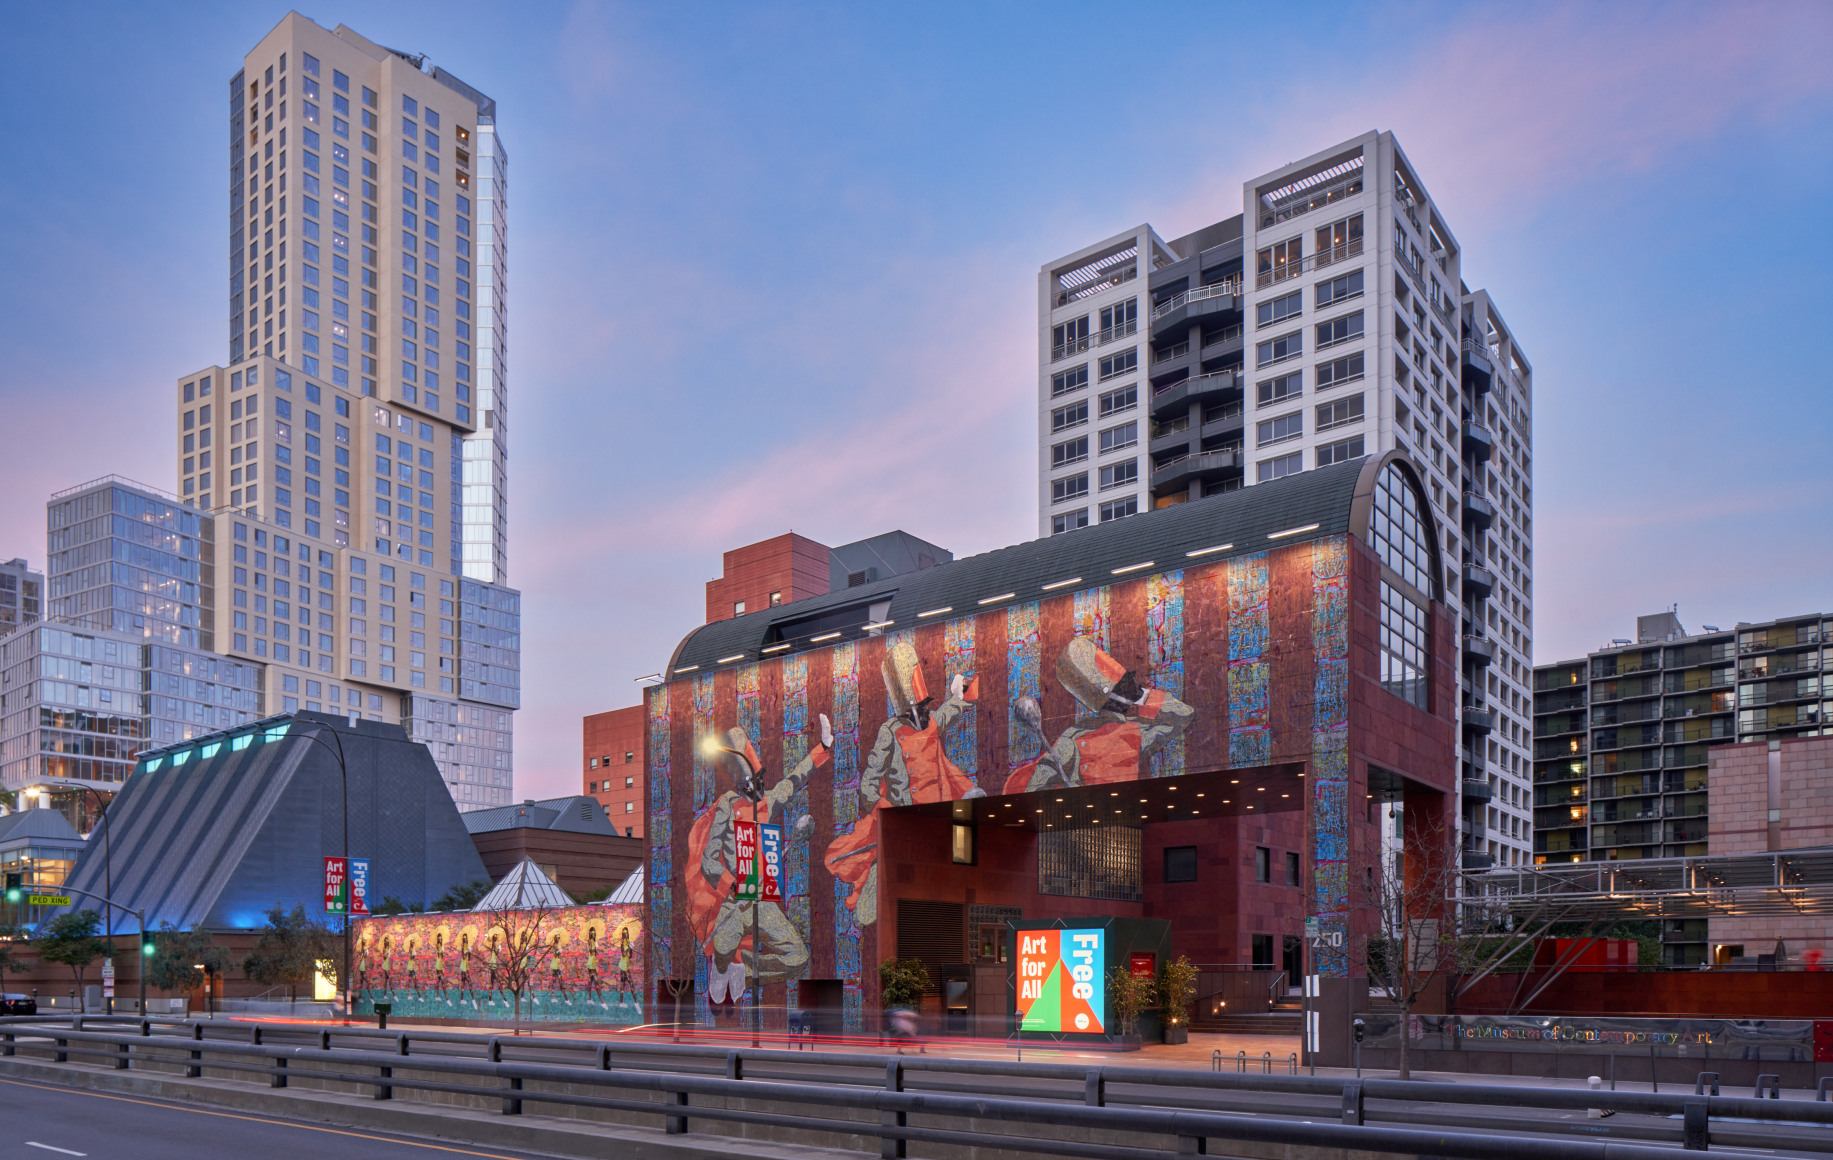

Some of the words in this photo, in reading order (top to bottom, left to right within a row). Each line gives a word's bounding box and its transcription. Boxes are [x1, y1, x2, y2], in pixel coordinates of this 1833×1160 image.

[736, 826, 753, 843] Art
[737, 841, 754, 858] for
[763, 828, 779, 877] Free
[326, 860, 343, 873] Art
[738, 859, 753, 875] All
[326, 872, 343, 884] for
[353, 862, 368, 897] Free
[326, 884, 341, 896] All
[32, 896, 48, 904] PED
[50, 897, 68, 905] XING
[1021, 935, 1047, 955] Art
[1021, 957, 1046, 977] for
[1072, 934, 1098, 999] Free
[1021, 979, 1042, 999] All
[1443, 1024, 1475, 1038] The
[1477, 1024, 1541, 1039] Museum
[1543, 1025, 1560, 1040] of
[1561, 1025, 1679, 1045] Contemporary
